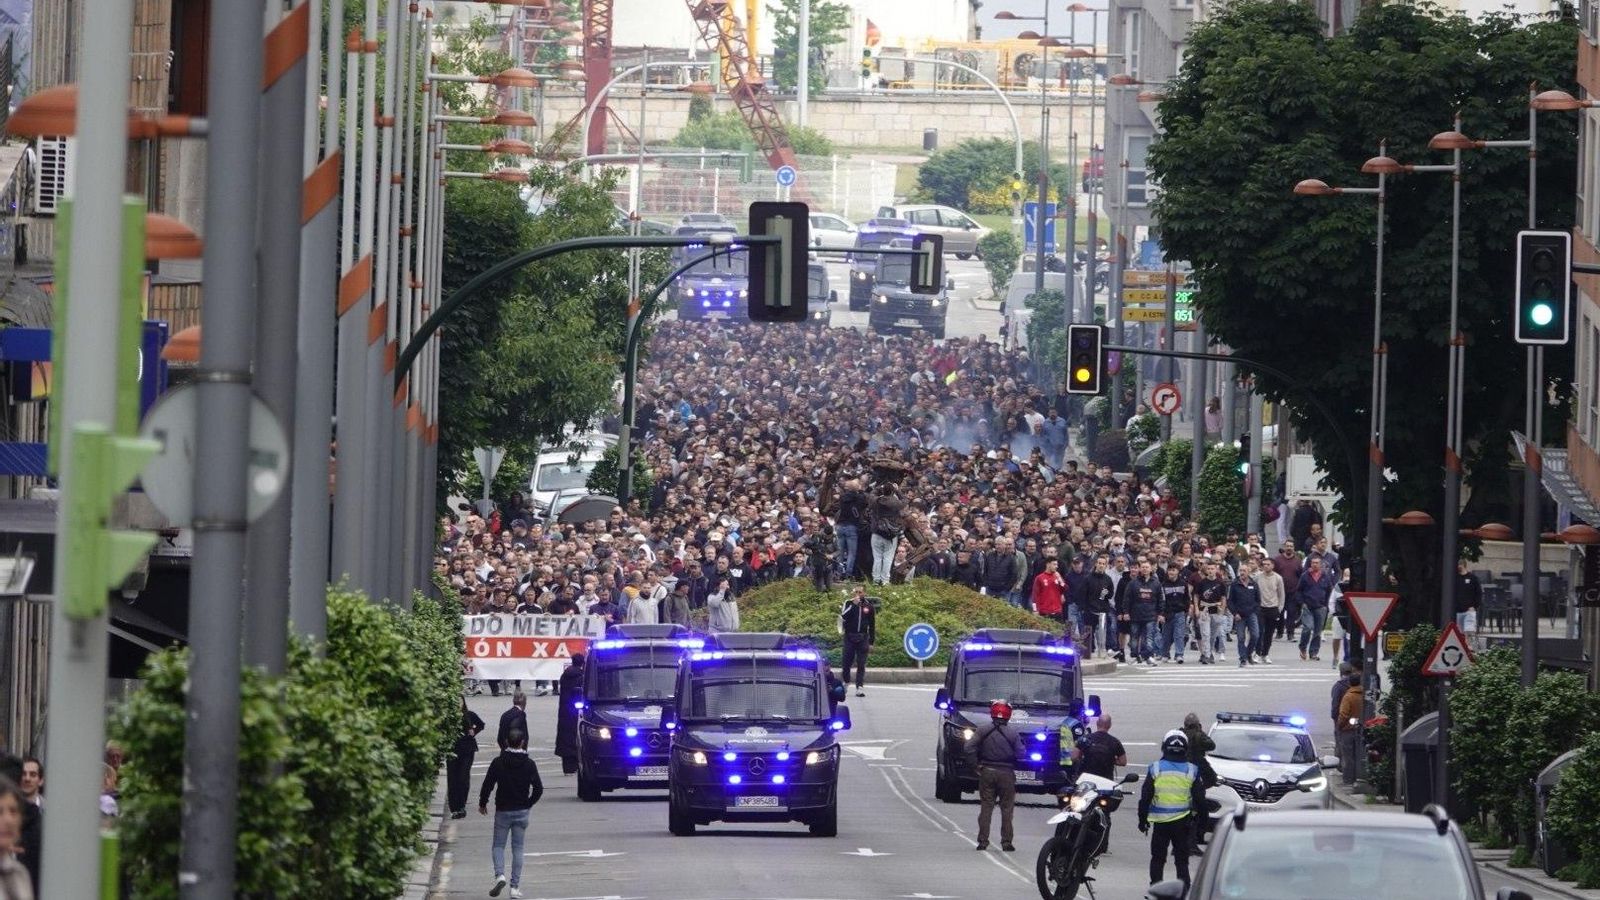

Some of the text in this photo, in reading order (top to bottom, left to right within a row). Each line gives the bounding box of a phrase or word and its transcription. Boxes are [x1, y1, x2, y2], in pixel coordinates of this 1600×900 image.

[470, 617, 597, 636] DO METAL
[463, 637, 571, 657] ÓN XA
